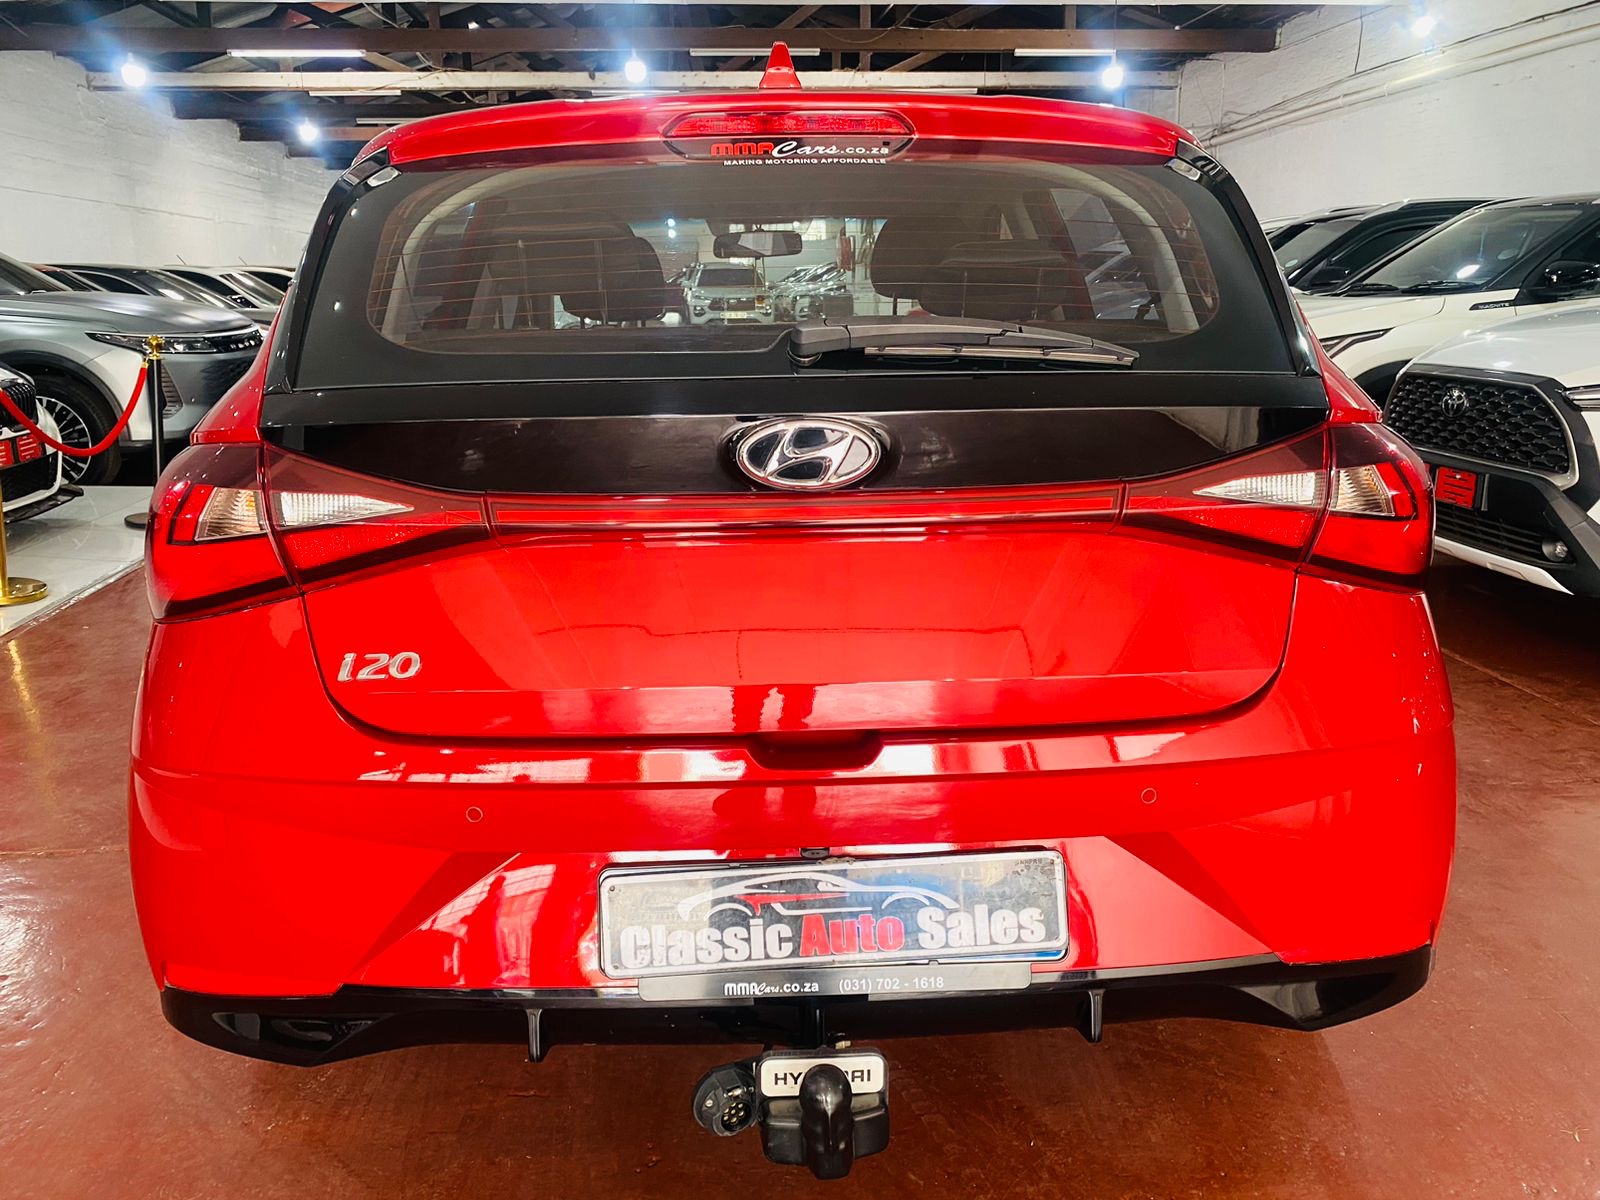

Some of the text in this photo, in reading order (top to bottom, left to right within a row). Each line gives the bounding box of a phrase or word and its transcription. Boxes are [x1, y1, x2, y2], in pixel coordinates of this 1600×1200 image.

[723, 159, 763, 167] MAKING
[820, 157, 887, 165] AFFORDABLE
[620, 903, 1047, 970] Classic Auto Sales
[839, 978, 873, 993] (031)
[876, 978, 900, 990] 702
[912, 977, 945, 989] 1618
[774, 1069, 871, 1086] HYAI
